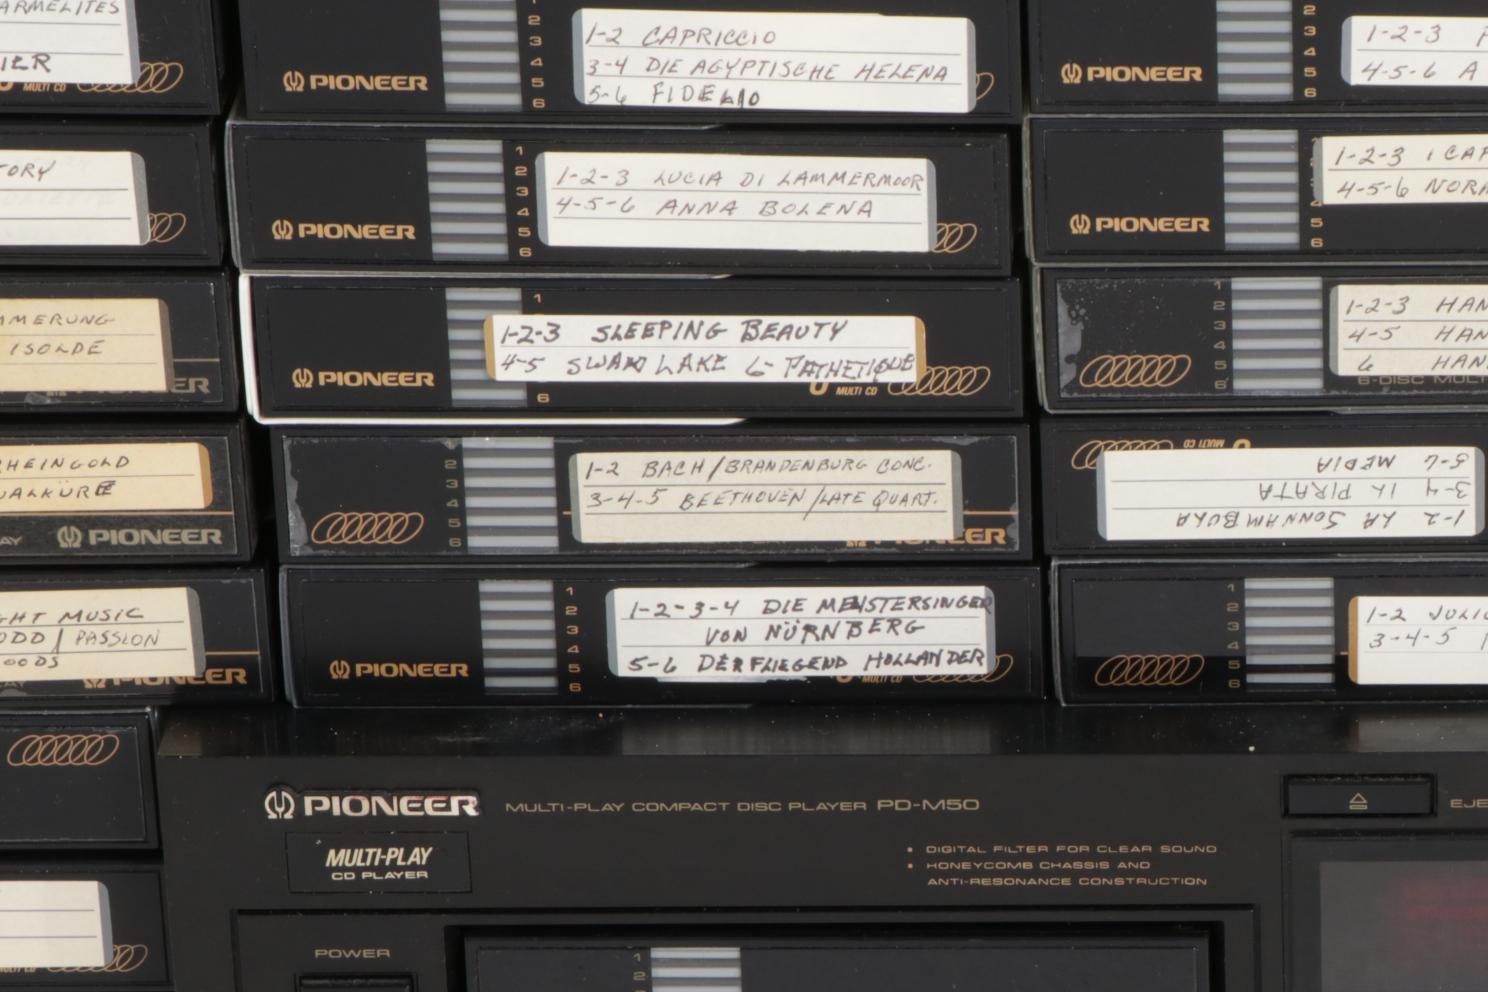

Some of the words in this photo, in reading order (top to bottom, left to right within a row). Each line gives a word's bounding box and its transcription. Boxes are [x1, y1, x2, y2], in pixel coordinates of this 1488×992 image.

[585, 26, 623, 46] 1-2
[642, 28, 776, 47] CAPRICCIO
[1367, 24, 1443, 45] 1-2-3
[586, 57, 628, 76] 3-4
[646, 56, 684, 75] DIE
[854, 63, 948, 82] HELENA
[1087, 66, 1203, 82] PIONEER
[1362, 62, 1437, 80] 4-5-6
[1458, 64, 1478, 81] A
[310, 75, 428, 91] PIONEER
[1334, 146, 1406, 167] 1-2-3
[556, 166, 630, 187] 1-2-3
[654, 169, 723, 187] LUCIA
[740, 170, 764, 187] DI
[777, 170, 924, 189] LAMMERMOOR
[1337, 176, 1409, 199] 4-5-6
[555, 196, 636, 215] 4-5-6
[656, 198, 738, 217] ANNA
[759, 199, 873, 218] BOLENA
[298, 224, 416, 240] PIONEER
[1095, 217, 1211, 233] PIONEER
[1345, 295, 1412, 315] 1-2-3
[501, 321, 561, 344] 1-2-3
[591, 319, 727, 343] SLEEPING
[740, 319, 849, 344] BEAUTY
[1348, 325, 1401, 343] 4-5
[9, 340, 105, 356] ISOLDE
[500, 353, 545, 373] 4-5
[656, 353, 729, 376] LAKE
[318, 371, 435, 387] PIONEER
[586, 461, 620, 479] 1-2
[587, 487, 668, 509] 3-4-5
[1259, 482, 1351, 500] PIRATA
[89, 528, 222, 545] PIONEER
[58, 608, 144, 624] MUSIC
[628, 599, 740, 619] 1-2-3-4
[762, 597, 807, 615] DIE
[1366, 607, 1407, 624] 1-2
[706, 627, 748, 646] VON
[1368, 626, 1458, 650] 3-4-5
[355, 663, 469, 678] PIONEER
[628, 656, 678, 674] 5-6
[864, 649, 986, 672] HOLLANDER
[304, 795, 481, 817] PIONEER
[505, 802, 625, 812] MULTI-PLAY
[632, 802, 730, 812] COMPACT
[737, 802, 782, 812] DISC
[788, 801, 867, 812] PLAYER
[877, 799, 980, 811] PD-M50
[326, 847, 432, 868] MULTI-PLAY
[926, 845, 987, 854] DIGITAL
[993, 845, 1049, 853] FILTER
[1056, 845, 1090, 853] FOR
[1097, 845, 1152, 853] CLEAR
[1160, 845, 1217, 853] SOUND
[926, 861, 1033, 870] HONEYCOMB
[1039, 861, 1110, 870] CHASSIS
[1117, 861, 1150, 869] AND
[332, 872, 356, 881] CD
[362, 870, 428, 880] PLAYER
[927, 878, 1072, 886] ANTI-RESONANCE
[1078, 877, 1208, 886] CONSTRUCTION
[314, 948, 391, 959] POWER
